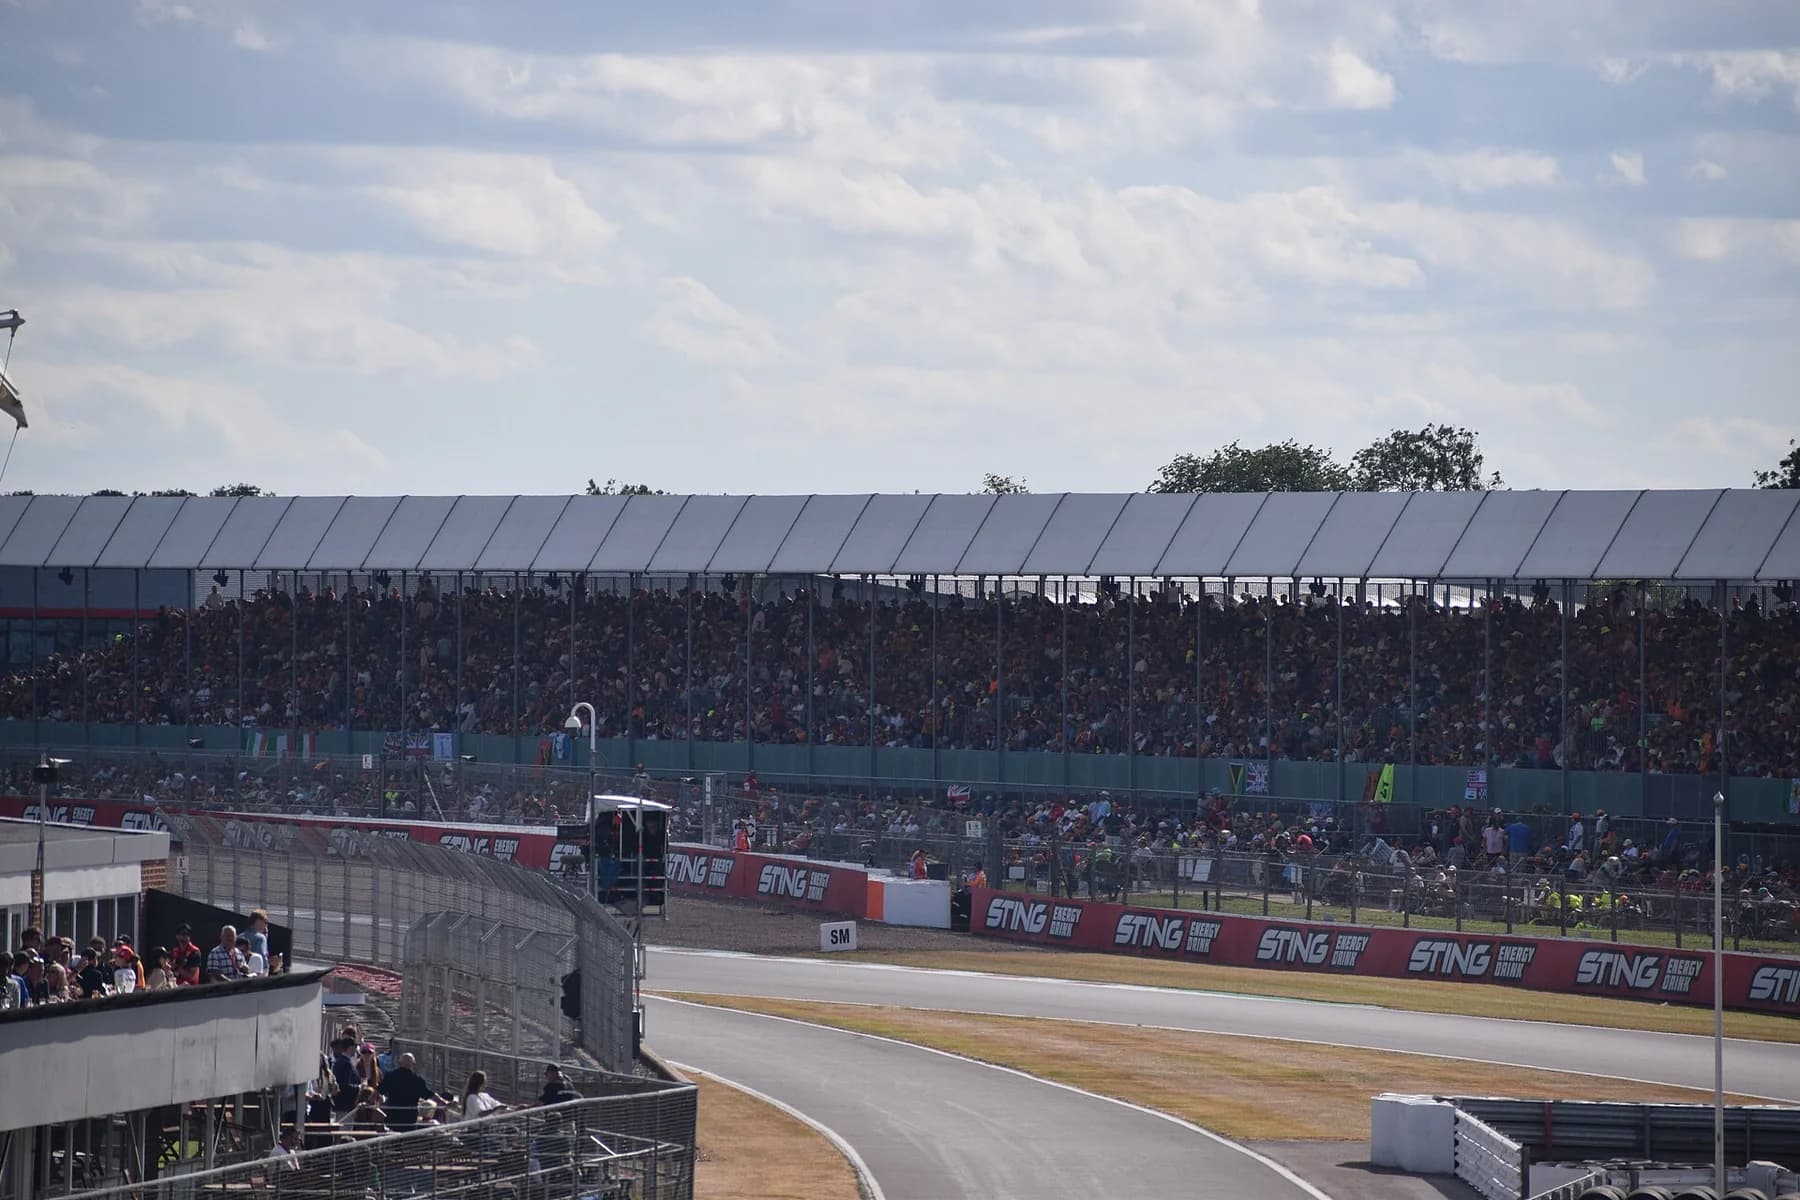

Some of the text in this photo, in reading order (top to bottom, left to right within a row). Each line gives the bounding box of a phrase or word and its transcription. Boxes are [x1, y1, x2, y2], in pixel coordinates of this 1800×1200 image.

[758, 865, 807, 898] STING
[986, 898, 1048, 933] STING
[1053, 906, 1082, 923] ENERGY
[830, 928, 850, 944] SM
[1049, 921, 1073, 937] DRINK
[1115, 914, 1184, 949] STING
[1189, 921, 1221, 939] ENERGY
[1186, 936, 1211, 953] DRINK
[1257, 929, 1329, 963] STING
[1336, 935, 1369, 952] ENERGY
[1332, 950, 1358, 966] DRINK
[1408, 941, 1491, 975] STING
[1498, 945, 1535, 962] ENERGY
[1494, 961, 1525, 978] DRINK
[1577, 952, 1659, 988] STING
[1667, 958, 1703, 977] ENERGY
[1662, 975, 1691, 993] DRINK
[1750, 967, 1800, 1003] STI
